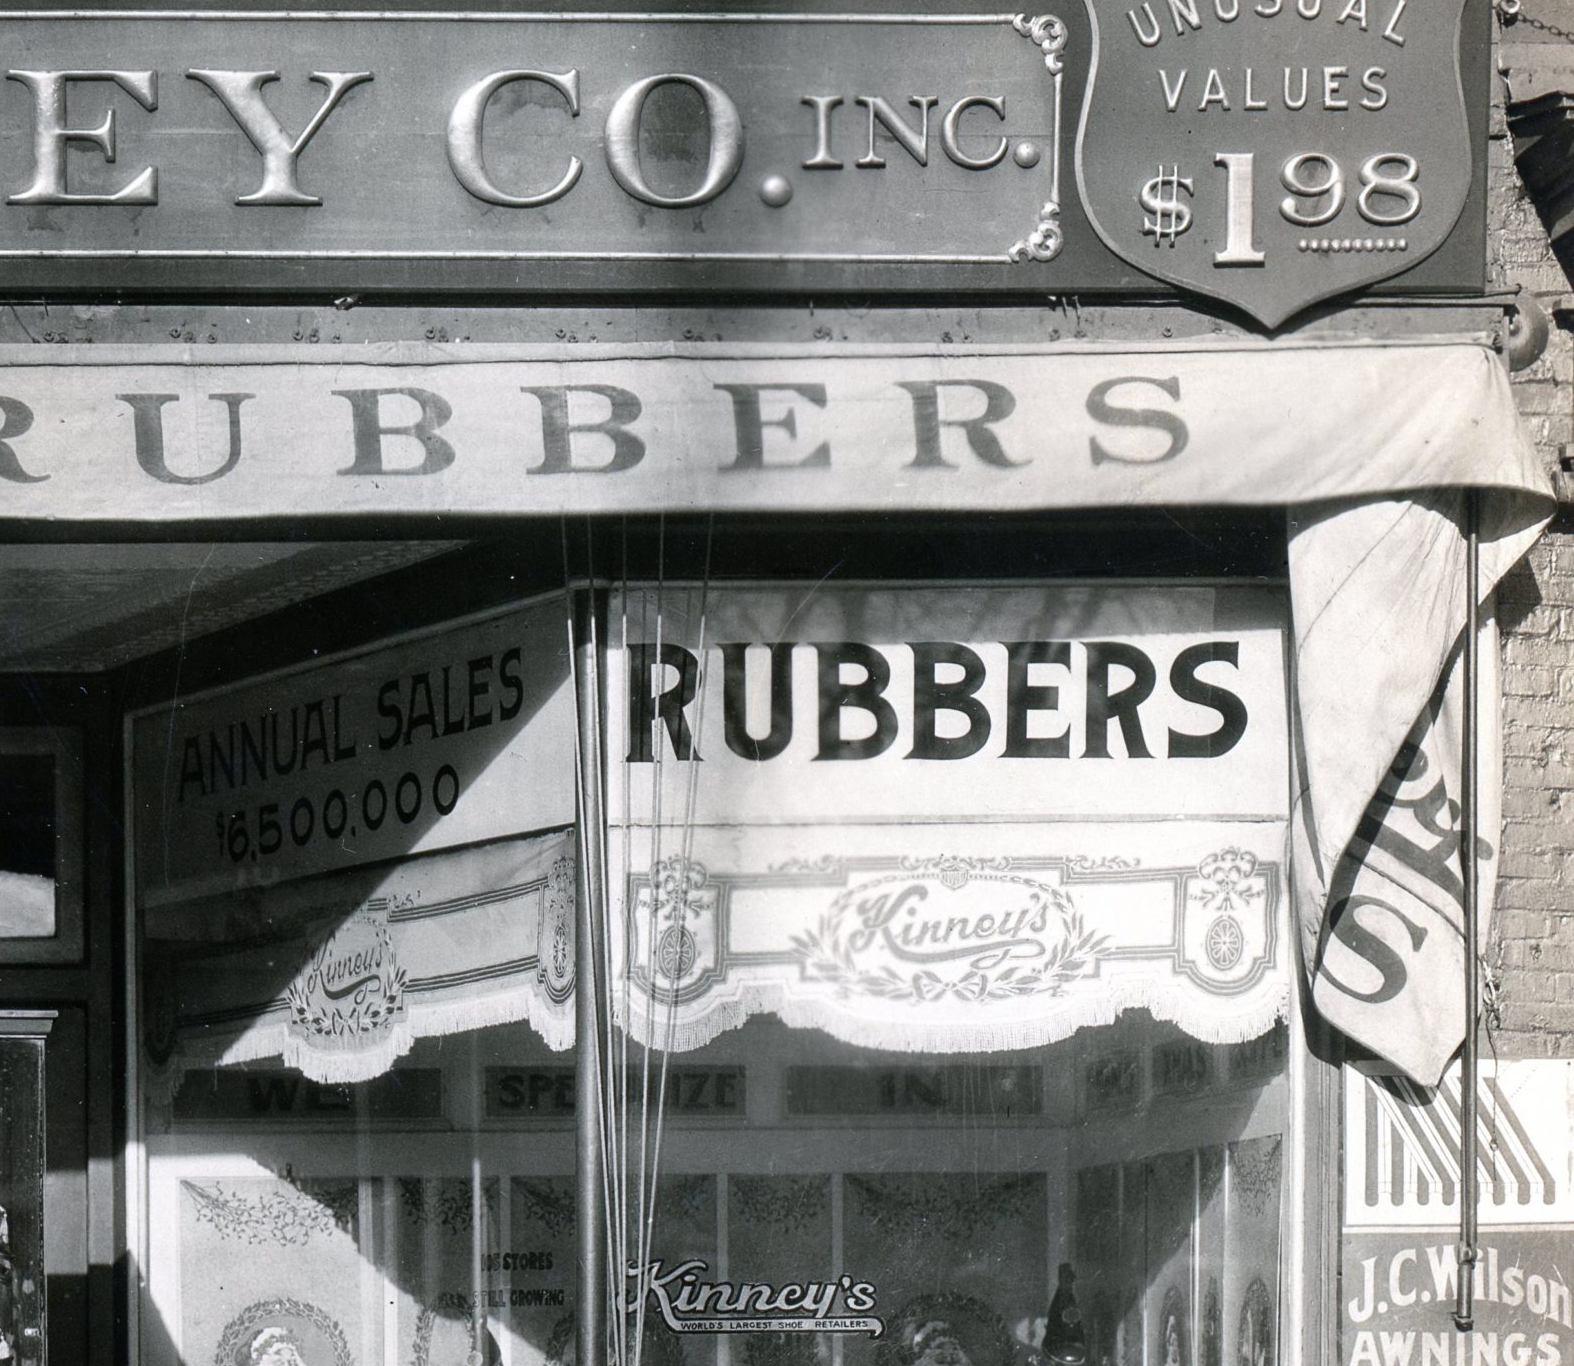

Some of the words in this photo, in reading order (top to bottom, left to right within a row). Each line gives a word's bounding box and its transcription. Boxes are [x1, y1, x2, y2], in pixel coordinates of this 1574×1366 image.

[1159, 66, 1389, 112] VALUES
[447, 67, 794, 209] CO.
[801, 93, 1041, 171] INC.
[178, 696, 357, 803] ANNUAL
[376, 646, 524, 751] SALES
[625, 640, 1250, 763] RUBBERS
[849, 884, 1048, 970] Kinney's
[503, 1252, 553, 1271] STORES
[614, 1259, 876, 1319] Kinney's
[510, 1288, 564, 1307] GROWING
[681, 1321, 723, 1331] WORLD'S
[729, 1321, 772, 1330] LARGEST
[779, 1320, 803, 1330] SHOE
[815, 1319, 868, 1329] RETAILERS
